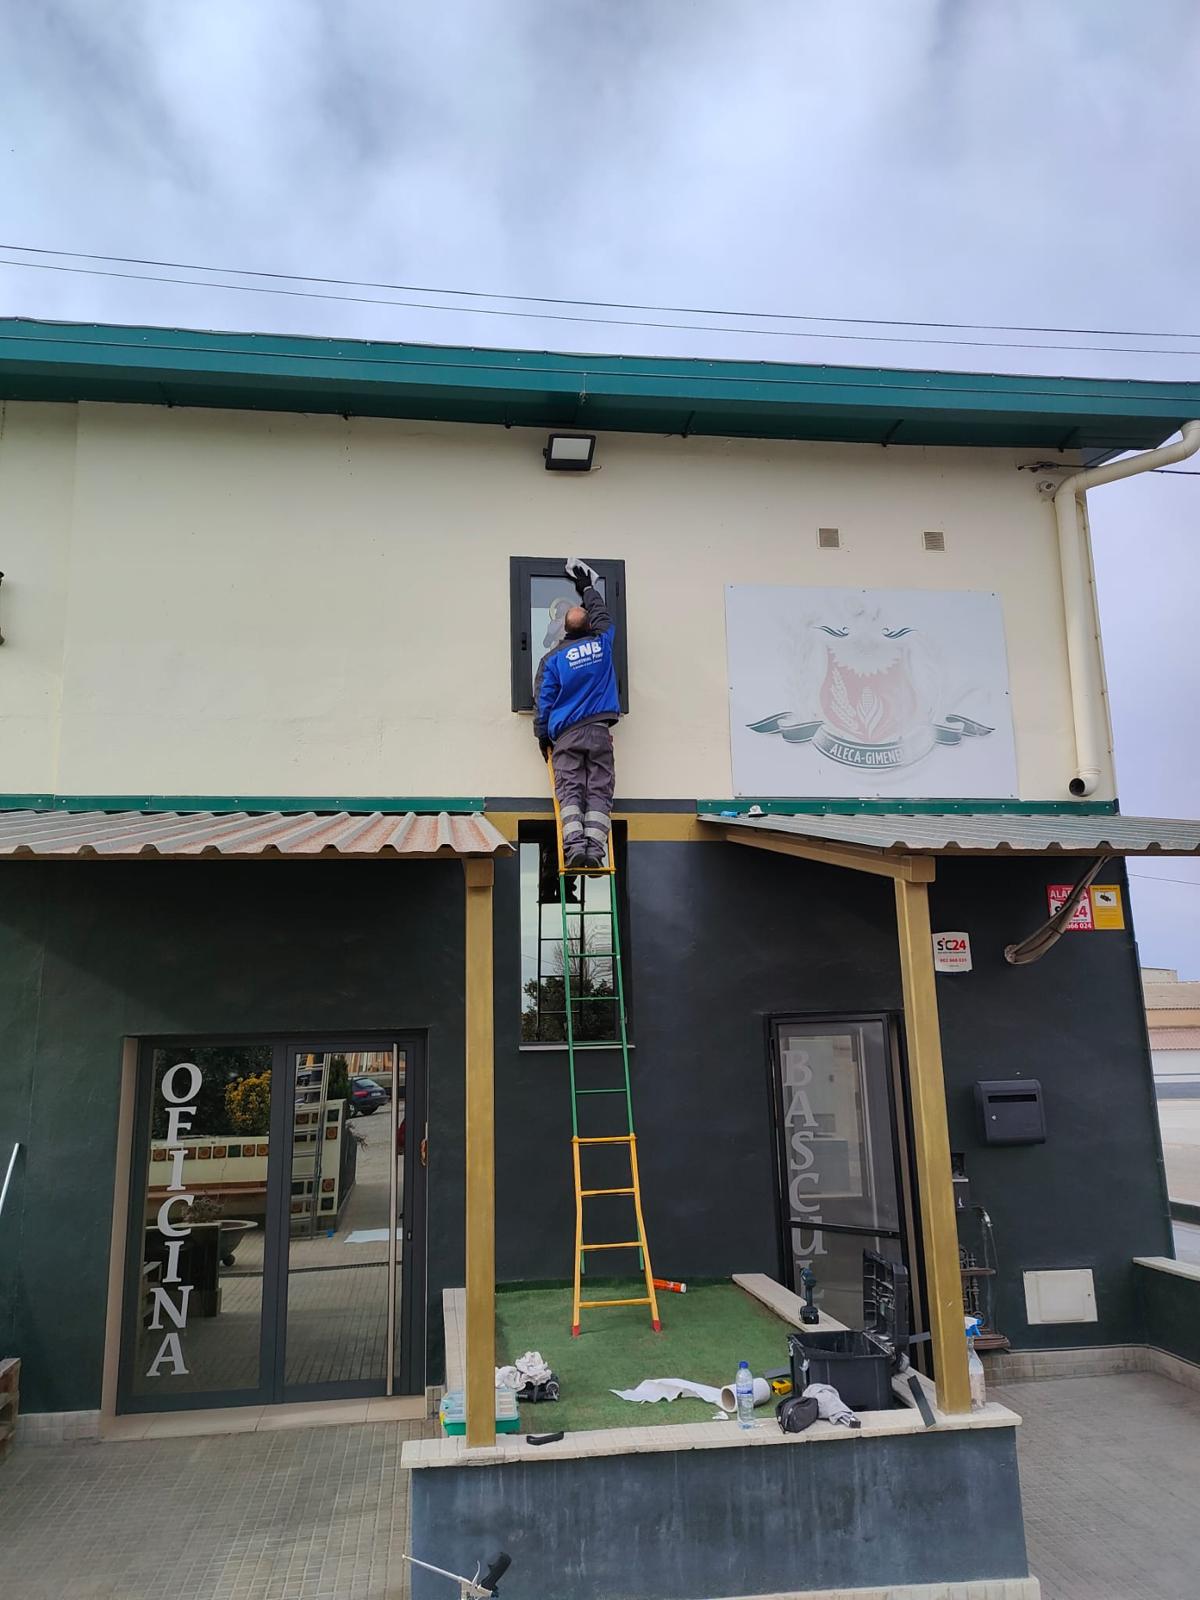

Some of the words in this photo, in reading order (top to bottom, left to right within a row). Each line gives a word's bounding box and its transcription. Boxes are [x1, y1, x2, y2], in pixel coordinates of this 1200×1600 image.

[566, 641, 602, 661] GNB
[1050, 889, 1089, 899] ALAA
[937, 939, 967, 951] SC24
[146, 1062, 203, 1377] OFICINA
